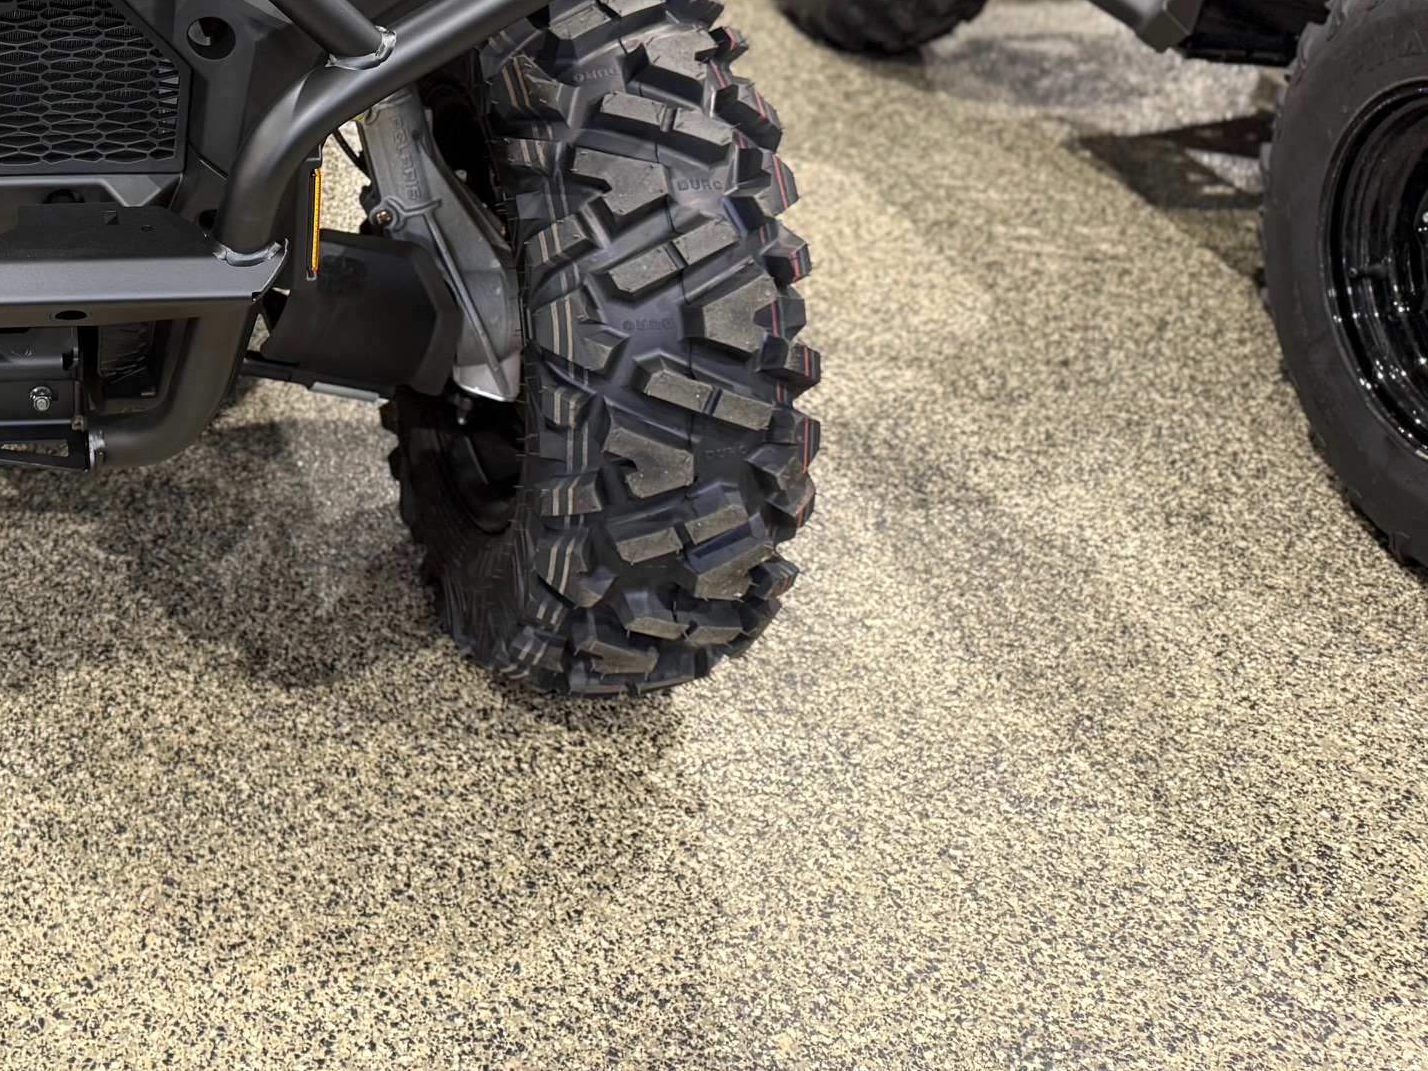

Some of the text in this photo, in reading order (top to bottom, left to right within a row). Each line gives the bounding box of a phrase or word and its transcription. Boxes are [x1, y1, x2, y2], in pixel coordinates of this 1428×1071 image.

[389, 113, 422, 201] POLARIS
[677, 179, 724, 191] DURO
[622, 317, 674, 331] DURO
